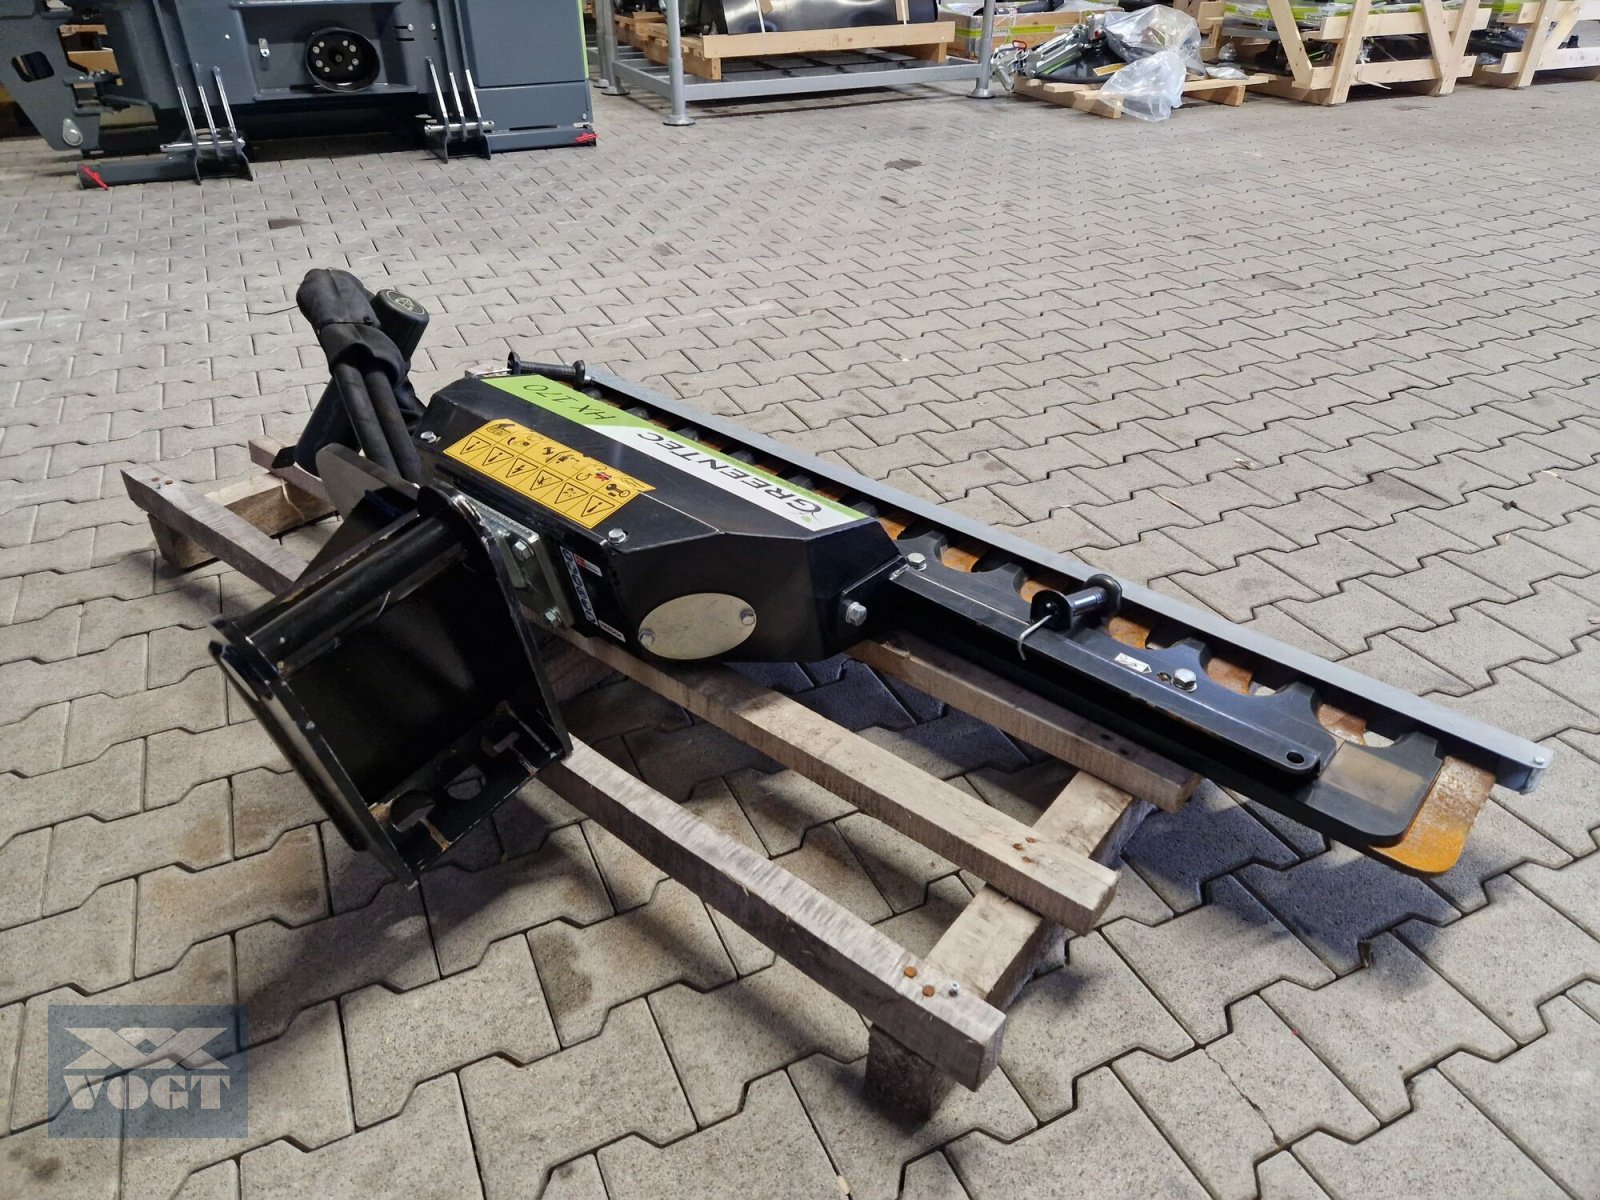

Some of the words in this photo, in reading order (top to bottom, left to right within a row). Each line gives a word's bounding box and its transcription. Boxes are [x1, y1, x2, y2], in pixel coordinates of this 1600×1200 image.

[523, 384, 579, 402] 170
[569, 404, 616, 421] HX
[637, 431, 823, 514] GREENTEC
